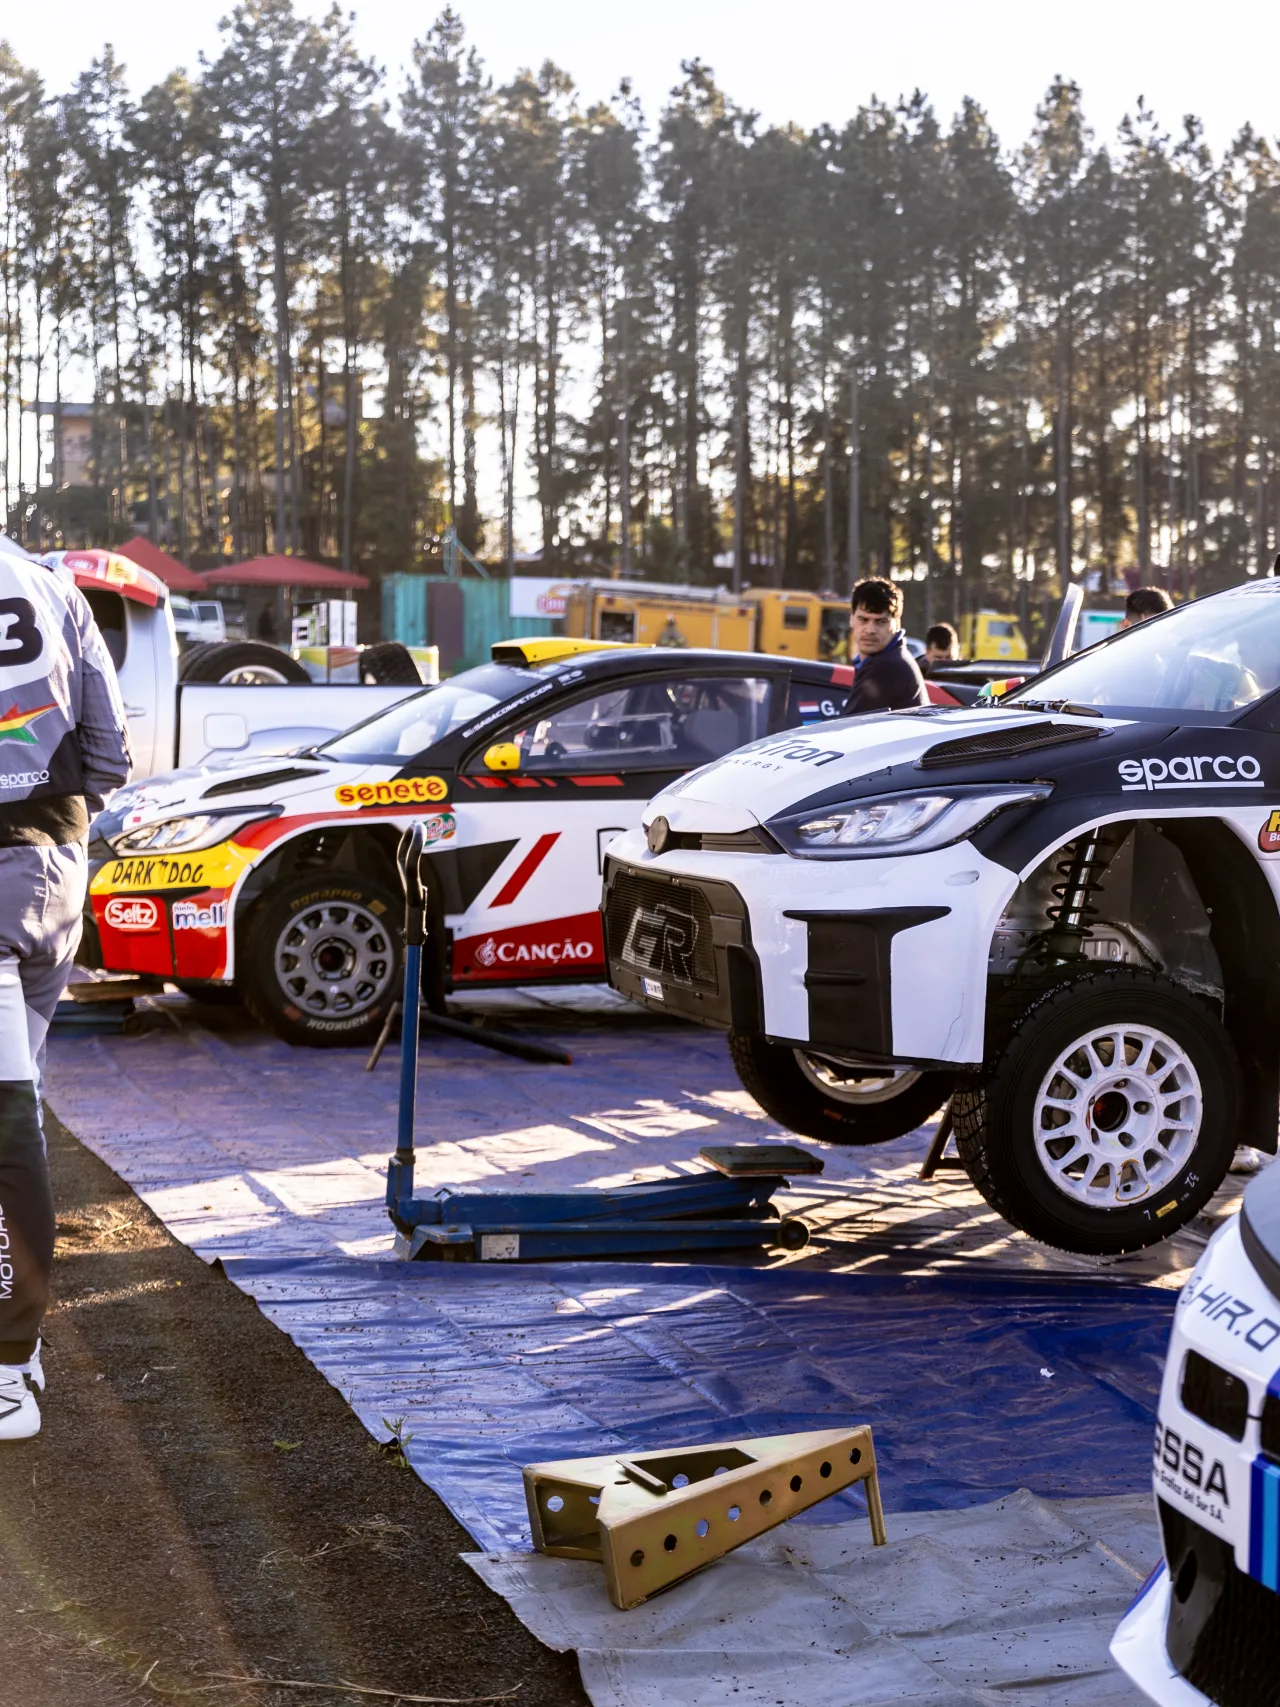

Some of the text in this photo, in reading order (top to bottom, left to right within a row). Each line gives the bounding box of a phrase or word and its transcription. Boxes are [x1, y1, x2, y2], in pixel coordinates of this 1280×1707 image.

[0, 769, 50, 789] sparco
[1118, 755, 1261, 790] sparco
[112, 860, 204, 884] DARK DOG
[110, 903, 153, 925] Seltz
